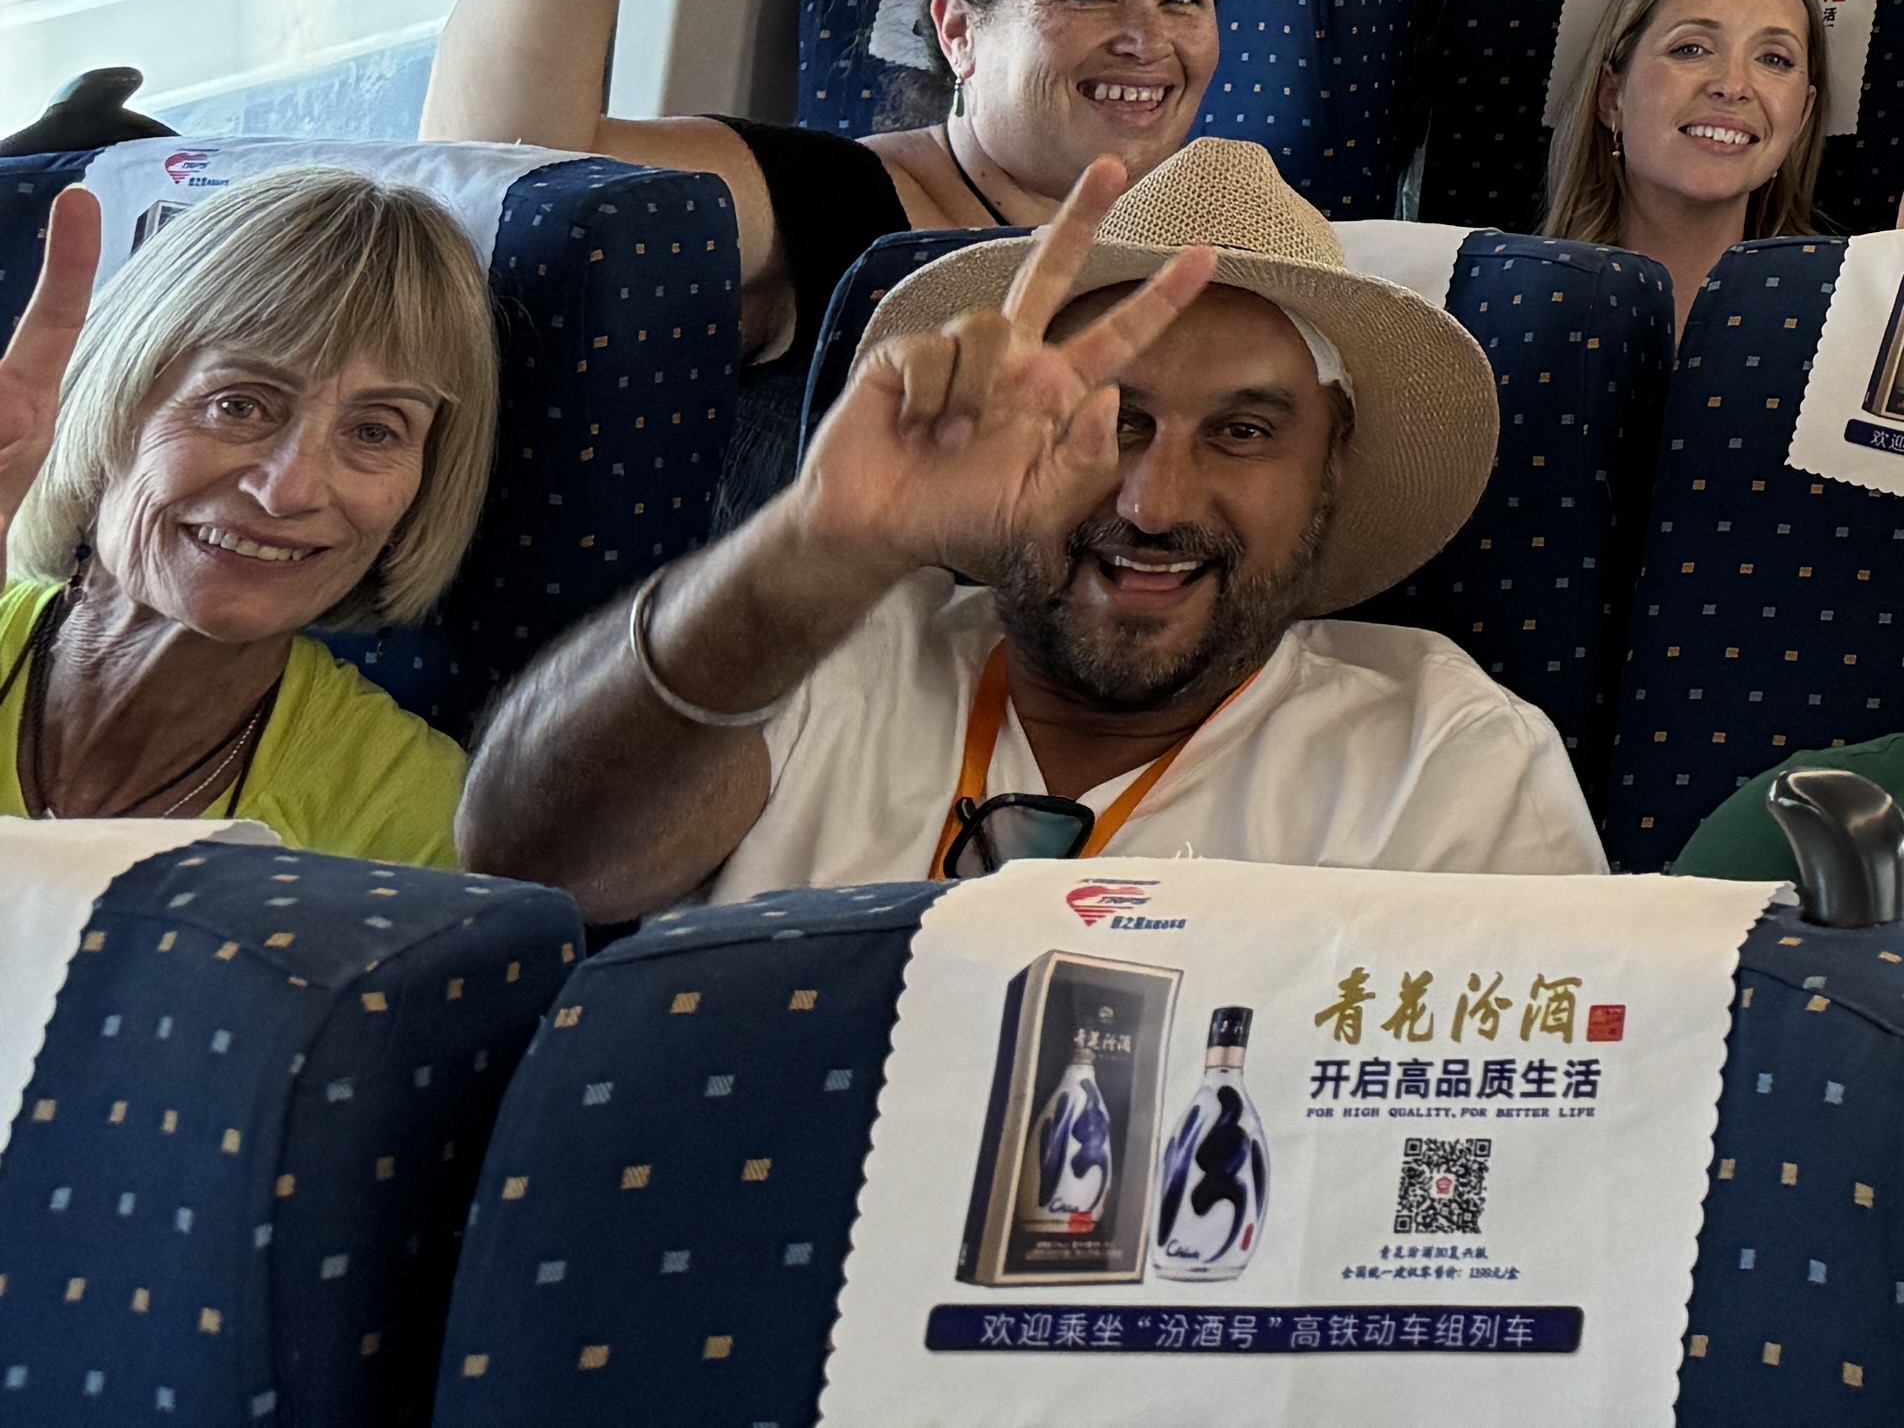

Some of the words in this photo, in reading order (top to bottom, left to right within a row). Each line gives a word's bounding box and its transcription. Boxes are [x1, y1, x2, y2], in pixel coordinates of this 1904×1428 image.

[1314, 966, 1584, 1046] 青花汾酒
[1310, 1055, 1603, 1101] 开启高品质生活
[1307, 1107, 1334, 1119] FOR
[1343, 1107, 1380, 1119] HIGH
[1496, 1107, 1550, 1119] BETTER
[1558, 1107, 1595, 1118] LIFE
[981, 1312, 1537, 1349] 欢迎乘坐“汾酒号”高铁动车组列车
